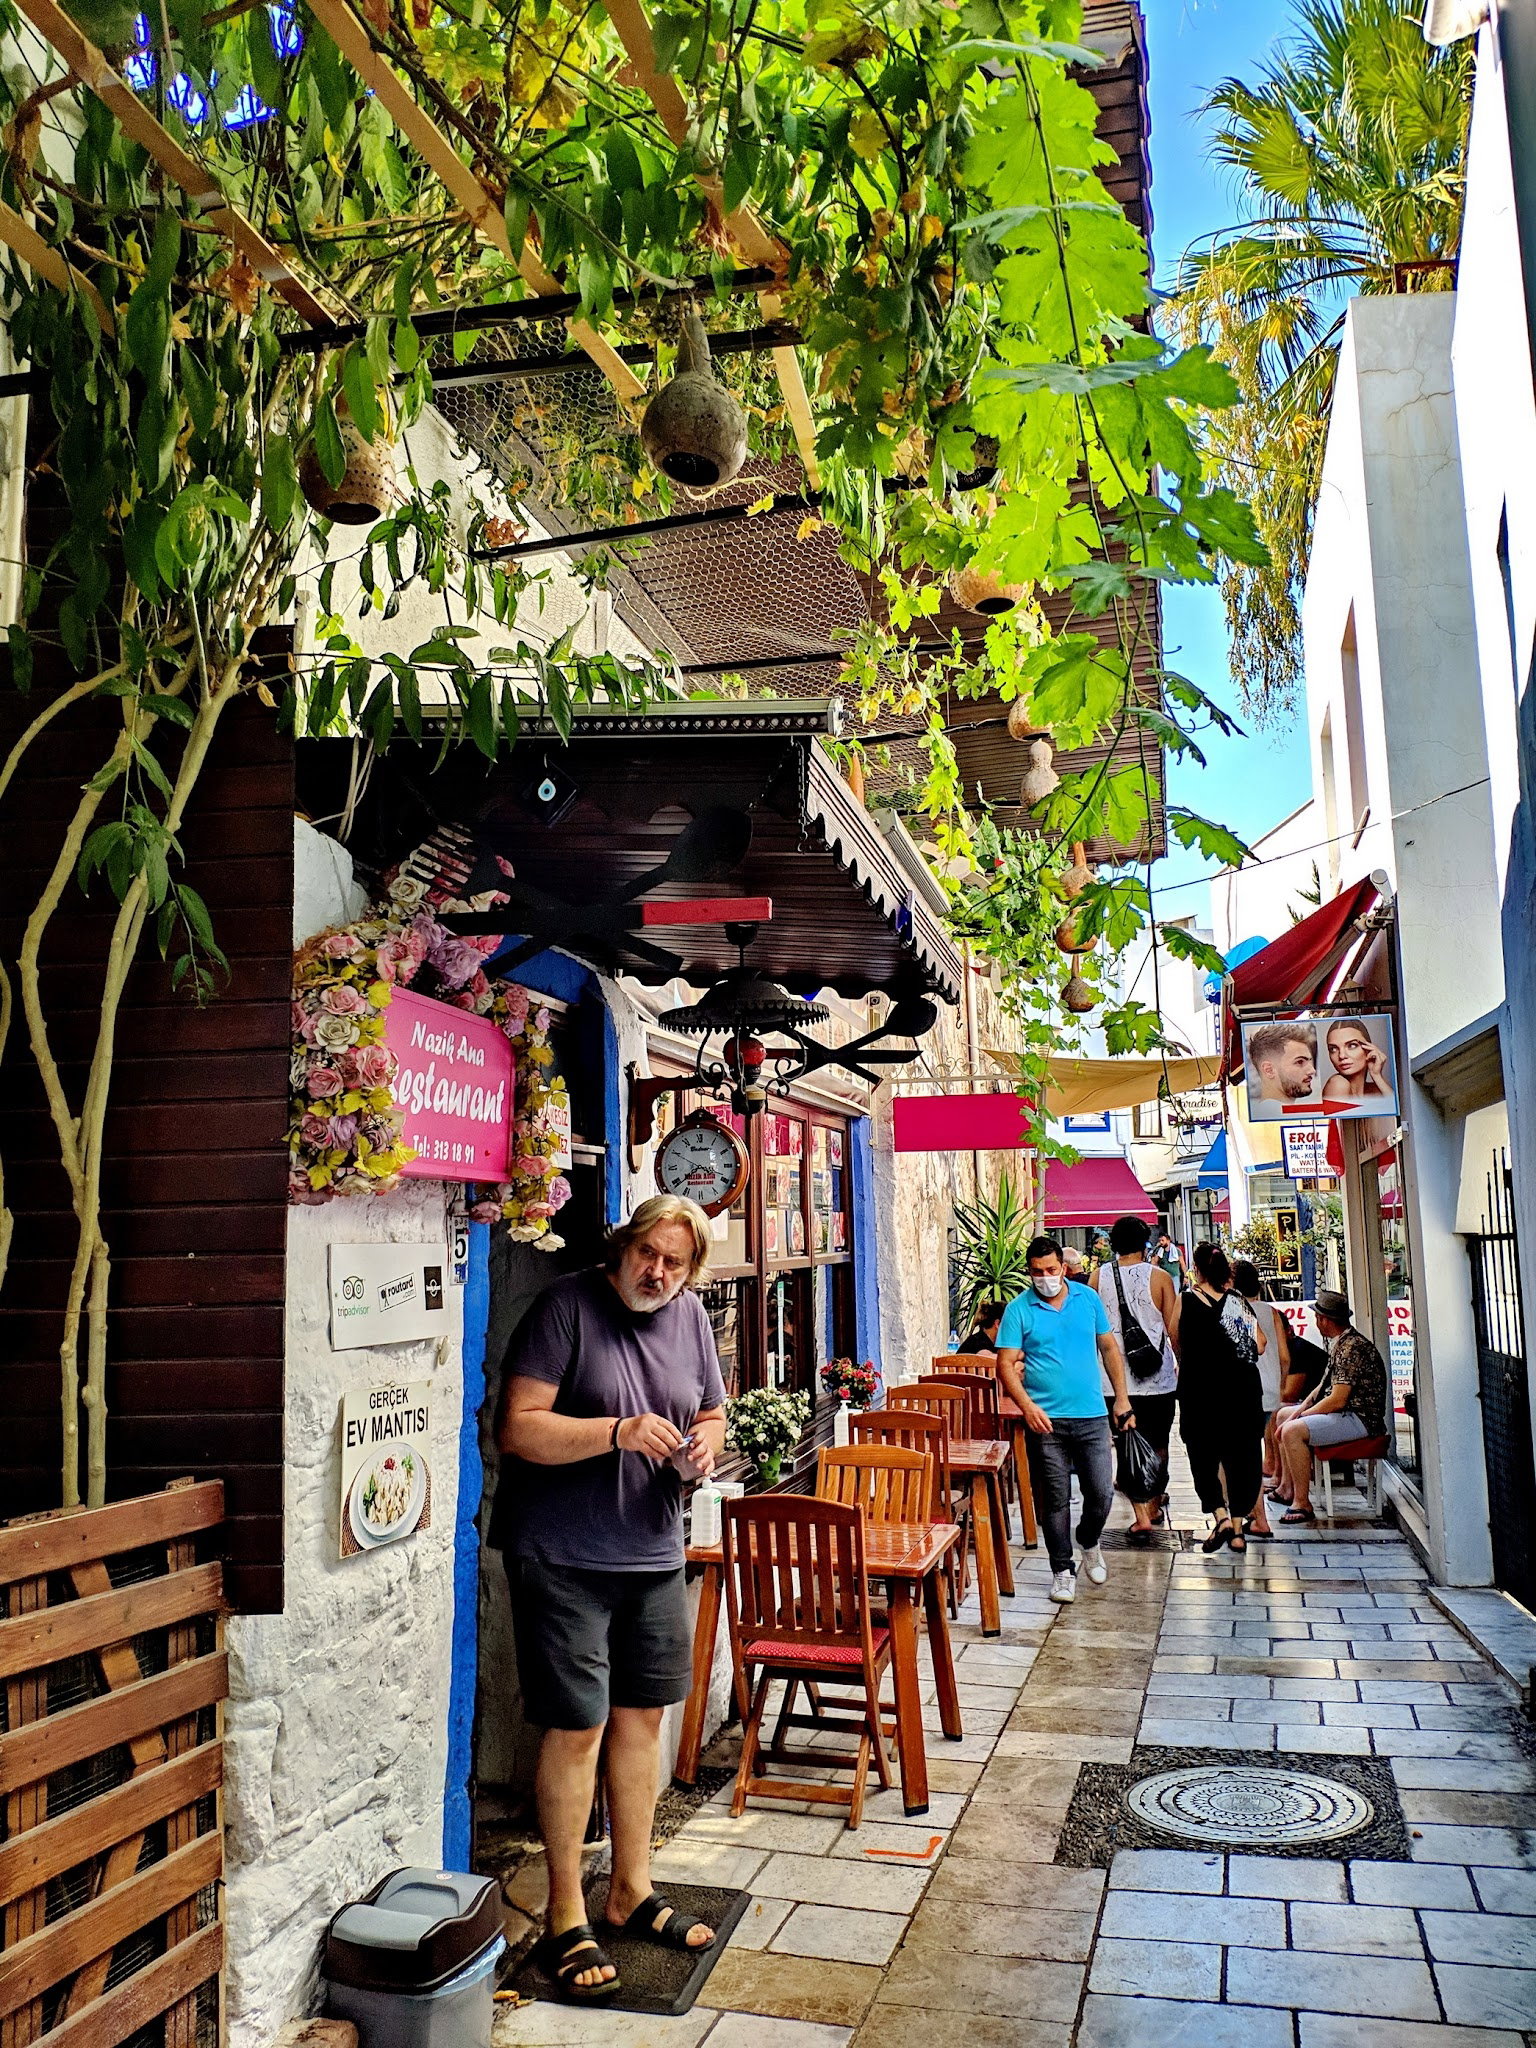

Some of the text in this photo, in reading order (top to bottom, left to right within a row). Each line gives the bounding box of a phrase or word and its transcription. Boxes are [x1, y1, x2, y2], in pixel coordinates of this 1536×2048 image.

[456, 1035, 485, 1067] Ana
[412, 1134, 475, 1164] Tel: 313 18 91
[1289, 1132, 1322, 1143] EROL
[454, 1228, 467, 1259] 5
[387, 1277, 414, 1298] routard
[337, 1305, 370, 1319] tripadvisor
[369, 1387, 409, 1411] GERÇEK
[347, 1406, 429, 1447] EV MANTISI
